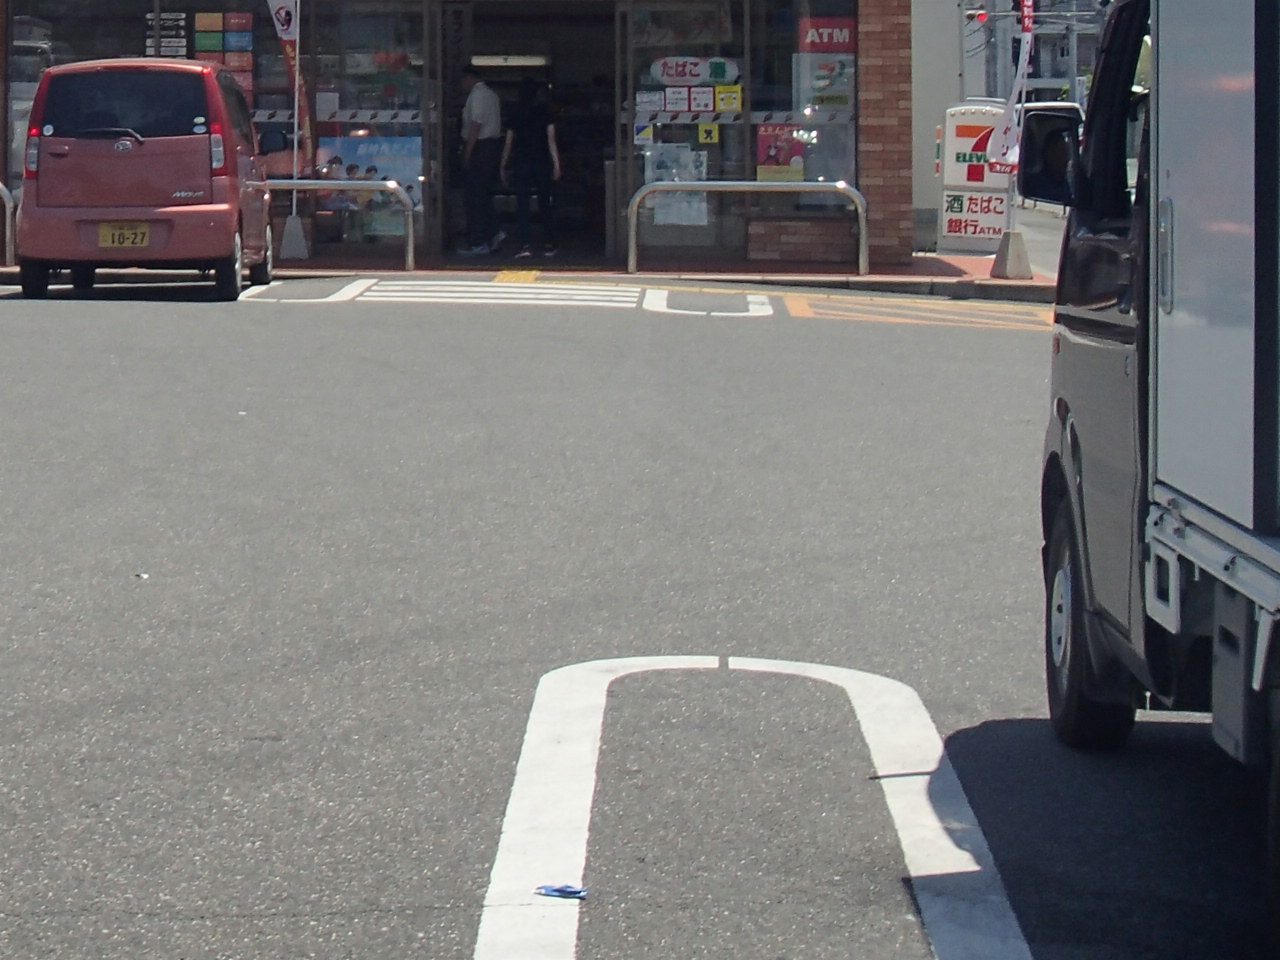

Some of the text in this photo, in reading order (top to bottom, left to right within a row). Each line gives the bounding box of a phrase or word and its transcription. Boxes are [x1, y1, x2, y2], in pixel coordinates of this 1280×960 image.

[805, 28, 850, 44] ATM
[661, 60, 701, 78] たばこ
[945, 195, 1005, 215] 酒 たばこ
[111, 231, 147, 246] 10-27
